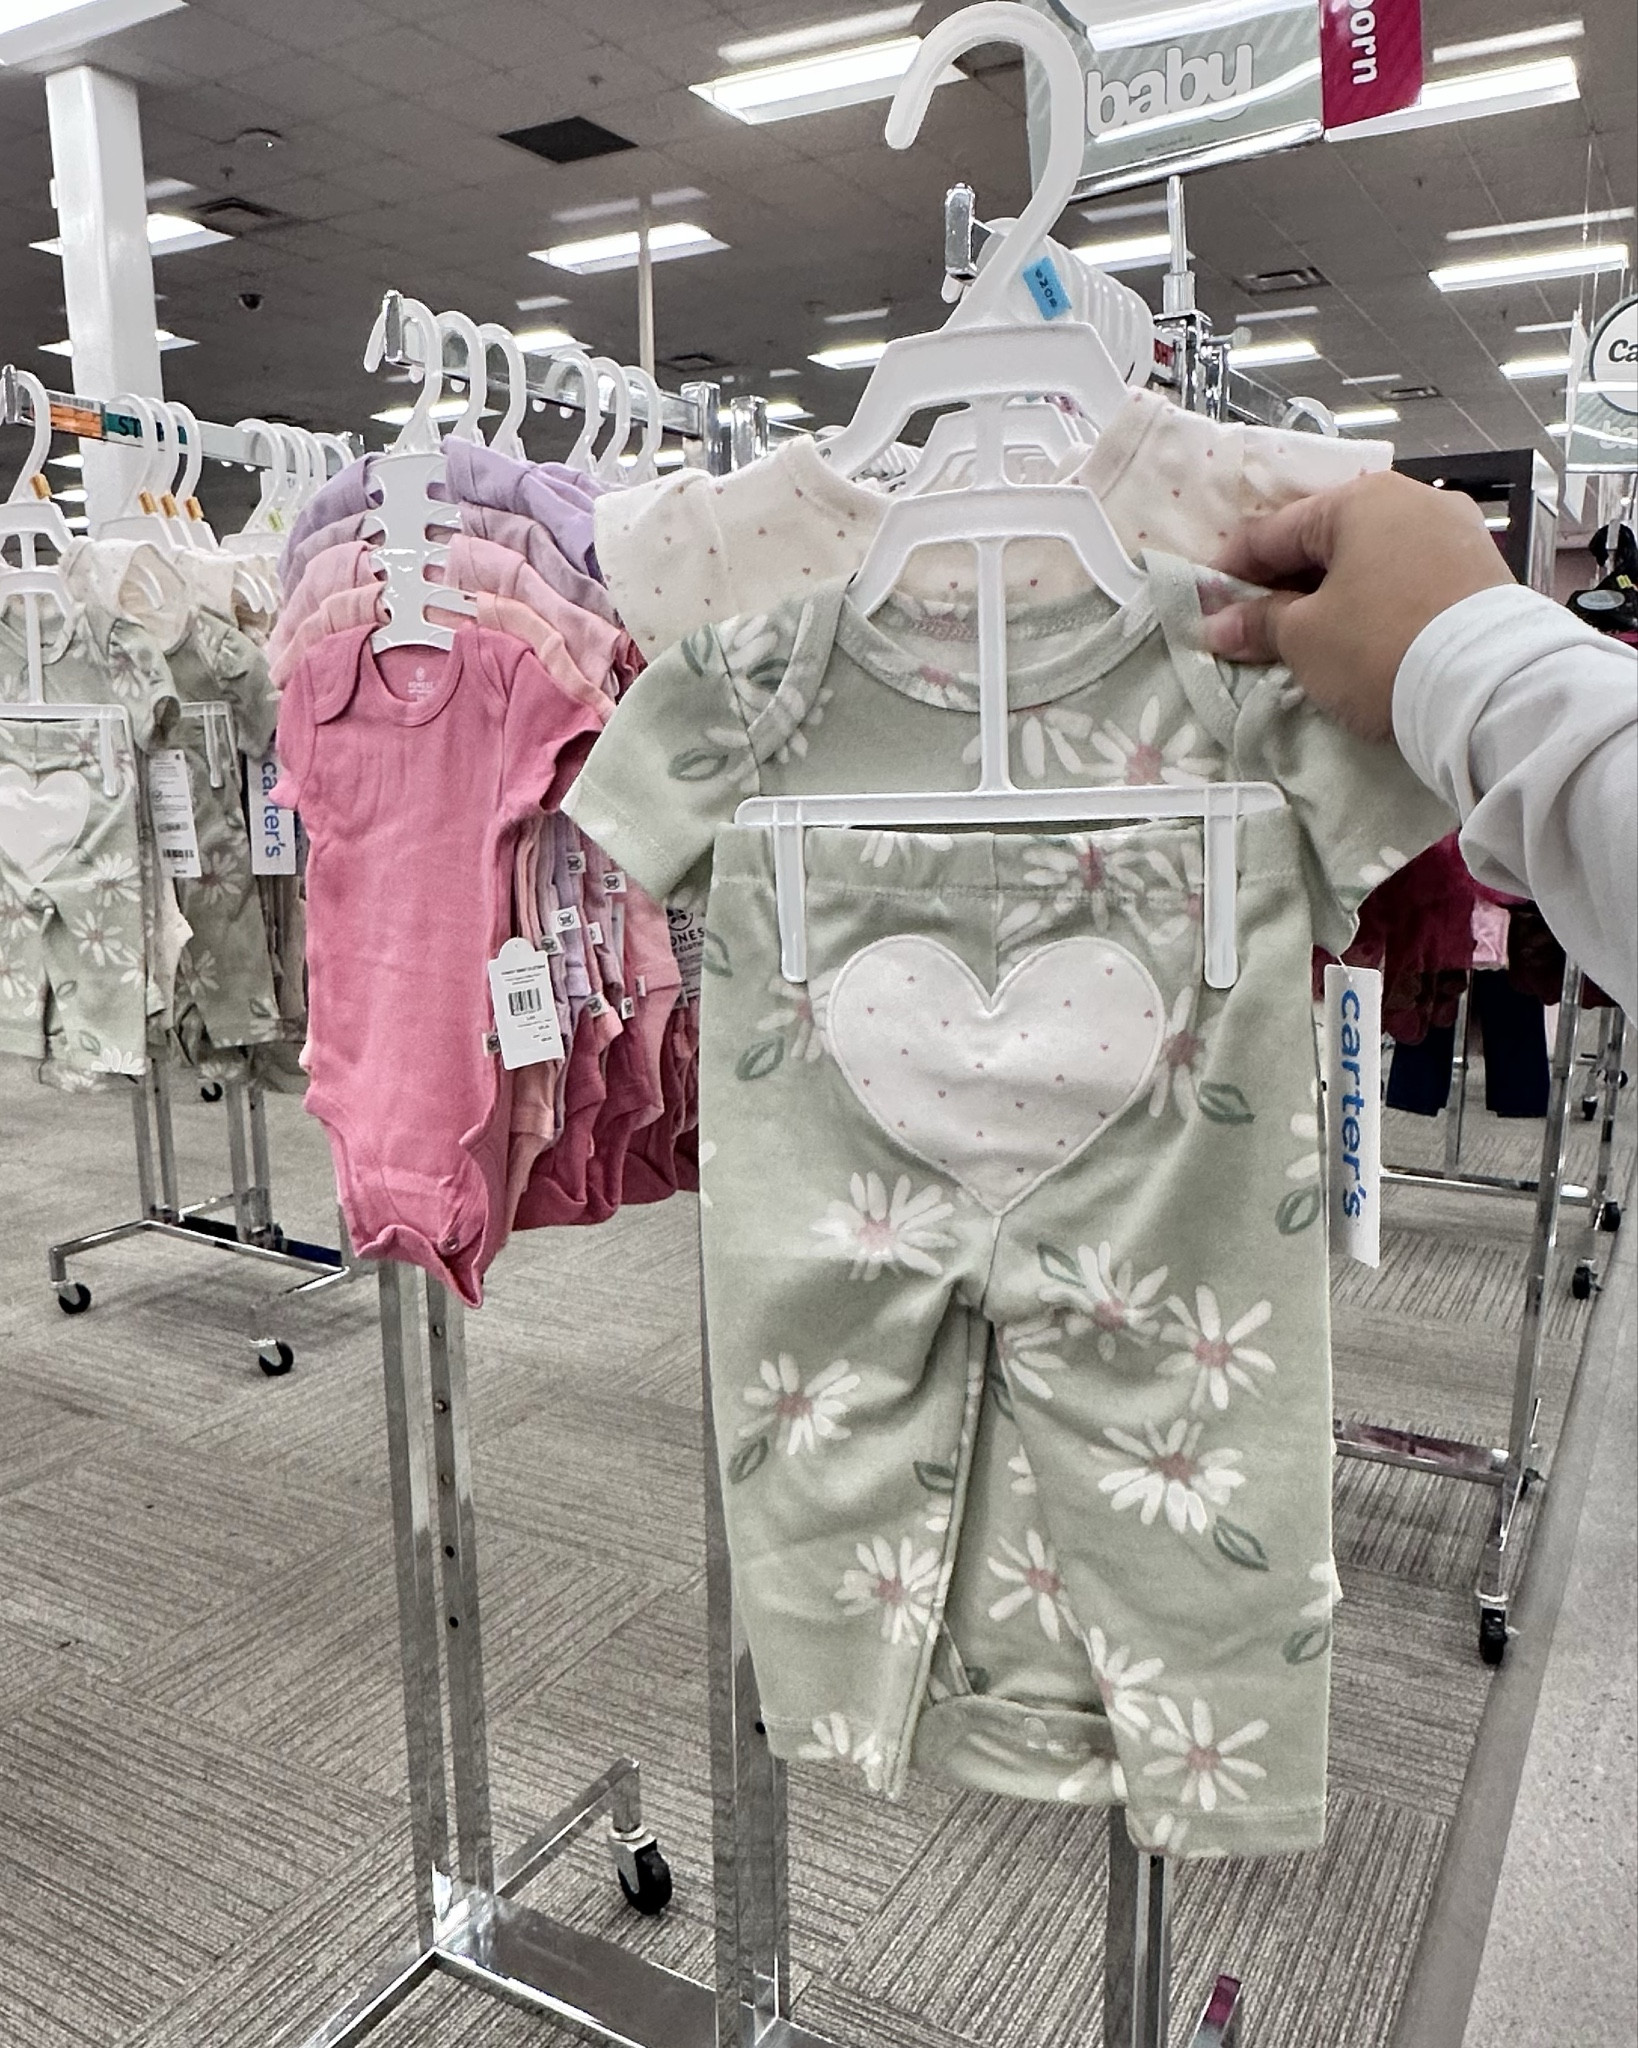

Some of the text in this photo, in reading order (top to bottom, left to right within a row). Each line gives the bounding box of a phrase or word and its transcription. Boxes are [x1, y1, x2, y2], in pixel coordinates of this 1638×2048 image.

[1086, 43, 1254, 138] baby
[261, 761, 286, 858] cater's
[1341, 988, 1367, 1219] carter's
